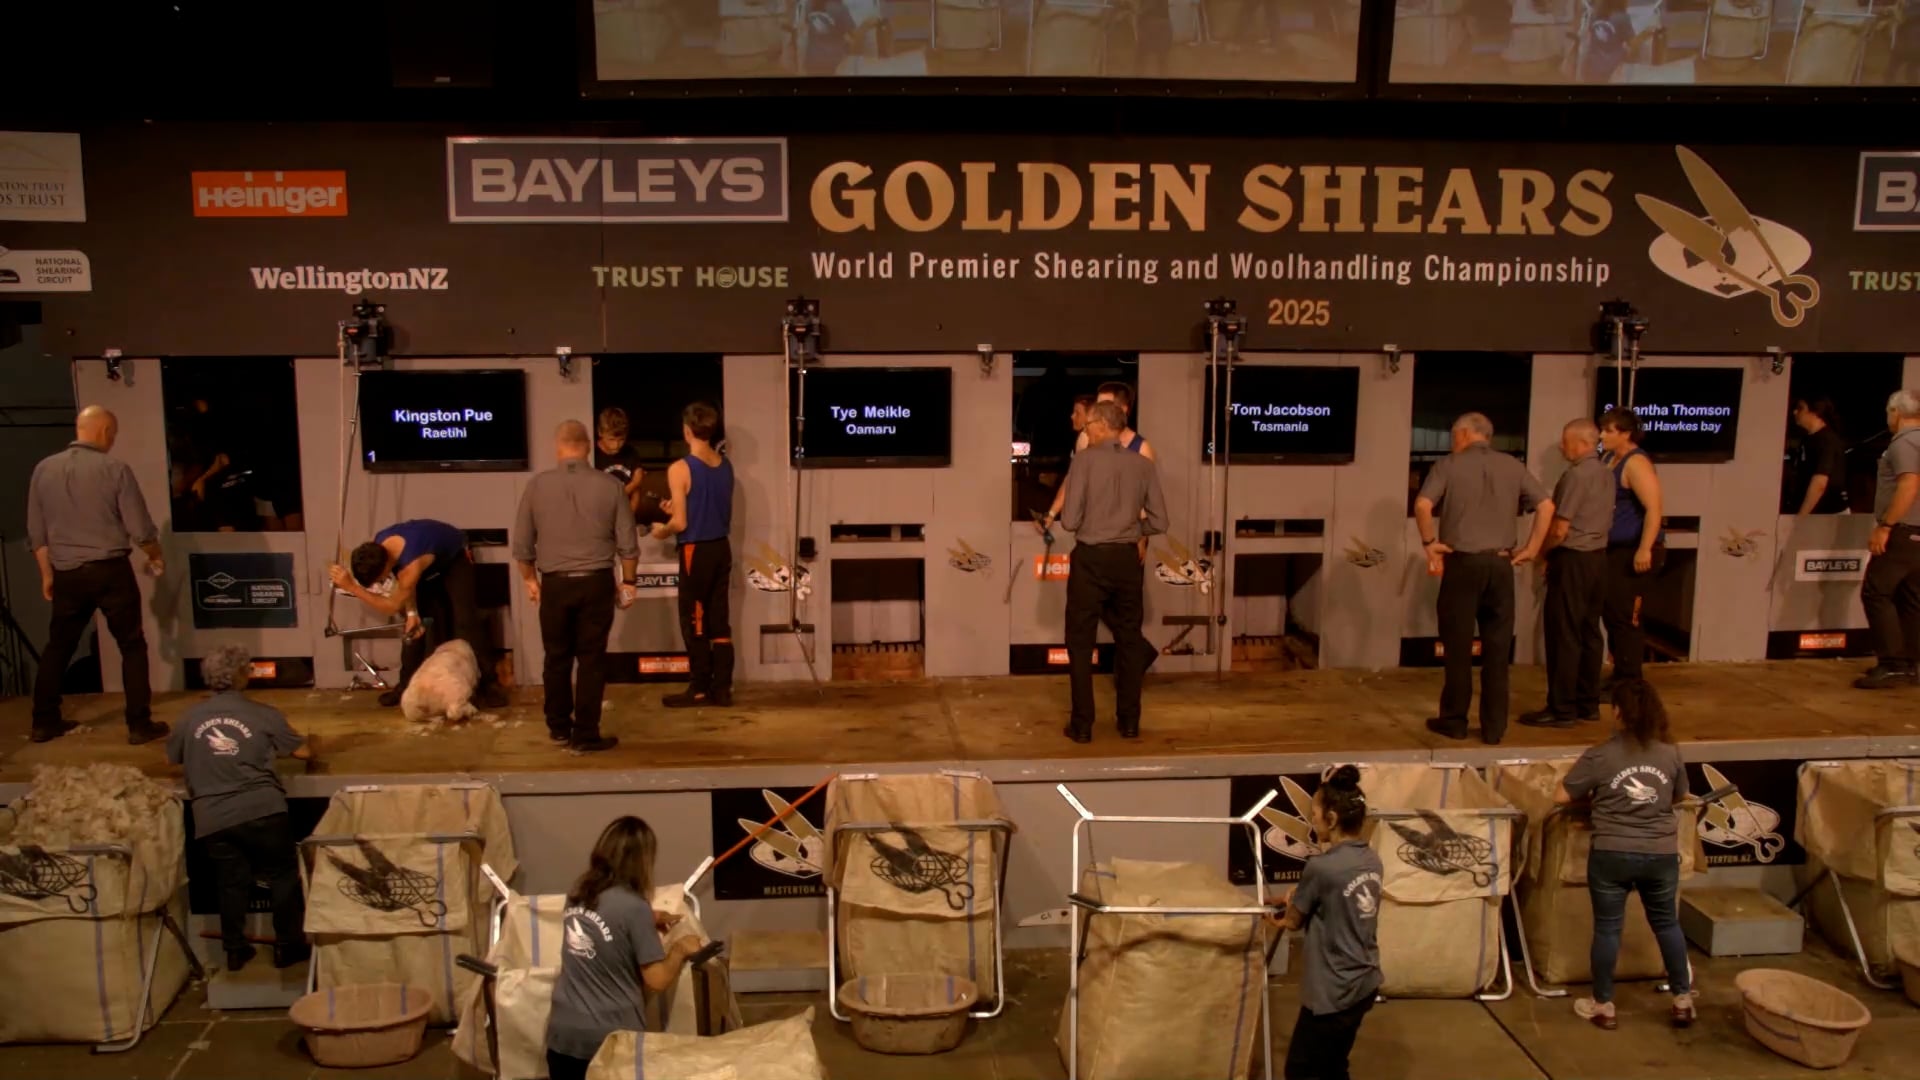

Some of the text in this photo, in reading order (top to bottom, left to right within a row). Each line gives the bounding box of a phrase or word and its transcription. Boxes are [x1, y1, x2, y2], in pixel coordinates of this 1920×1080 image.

[471, 157, 765, 203] BAYLEYS
[32, 182, 65, 192] TRUST
[199, 171, 343, 214] Heiniger
[19, 194, 66, 207] TRUST
[810, 160, 1615, 237] GOLDEN SHEARS
[35, 257, 82, 266] NATIONAL
[36, 267, 83, 275] SHEARING
[811, 251, 1610, 288] World Premier Shearing and Woolhandling Championship
[37, 276, 73, 285] CIRCUIT
[250, 266, 449, 295] WellingtonNZ
[592, 266, 789, 289] TRUST HOUSE
[1848, 270, 1920, 292] TRUST
[1267, 298, 1331, 327] 2025
[830, 406, 911, 421] Tye Meikle
[1231, 403, 1331, 416] Tom Jacobson
[1672, 404, 1731, 417] Thomson
[394, 409, 493, 425] Kingston Pue
[422, 427, 467, 438] Raetihi
[846, 424, 897, 435] Oamaru
[1251, 420, 1309, 432] Tasmania
[1654, 421, 1698, 431] Hawkes
[1700, 421, 1722, 433] bay
[368, 451, 376, 463] 1
[1806, 560, 1858, 571] BAYLEYS
